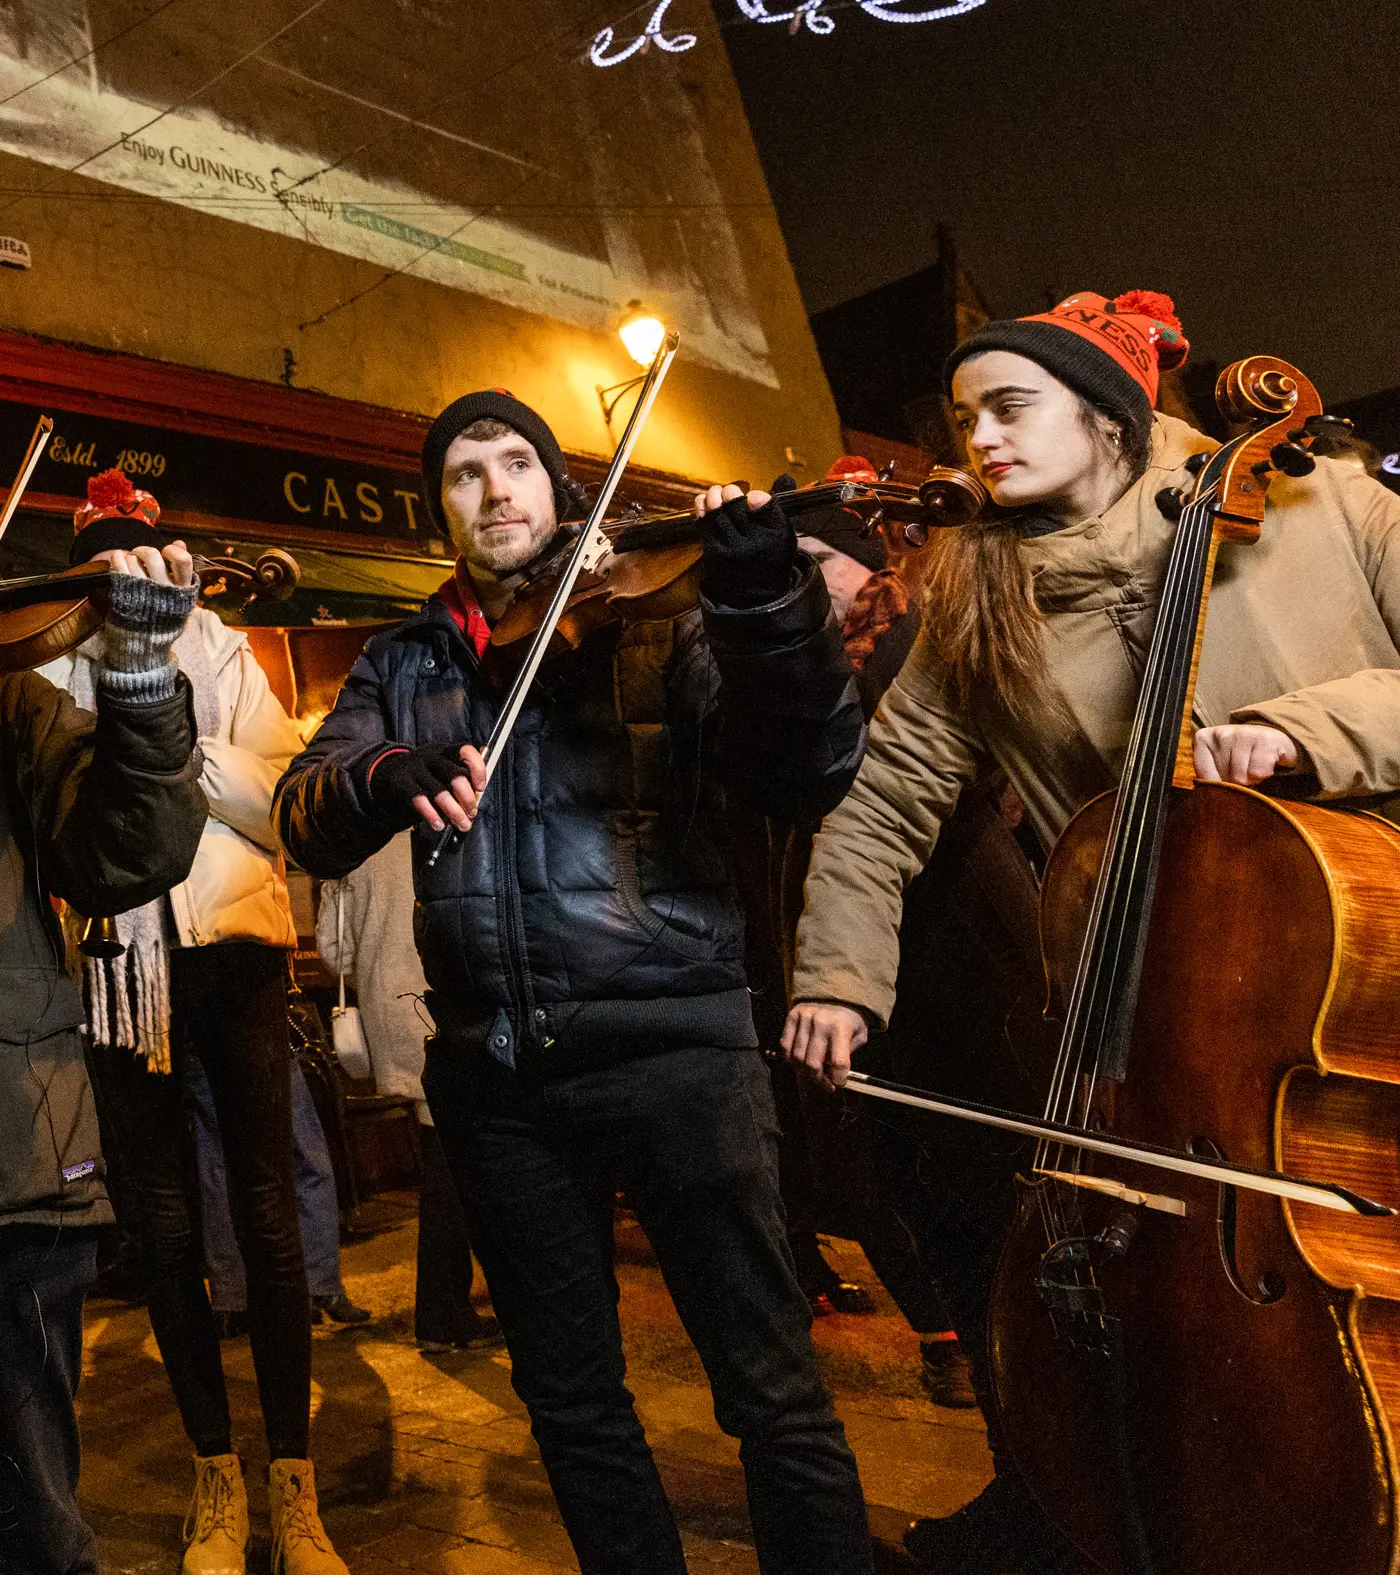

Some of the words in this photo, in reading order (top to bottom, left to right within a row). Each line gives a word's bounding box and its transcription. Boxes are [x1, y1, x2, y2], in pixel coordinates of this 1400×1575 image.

[121, 132, 165, 166] Enjoy
[170, 146, 267, 194] GUINNESS
[115, 449, 167, 478] 1899
